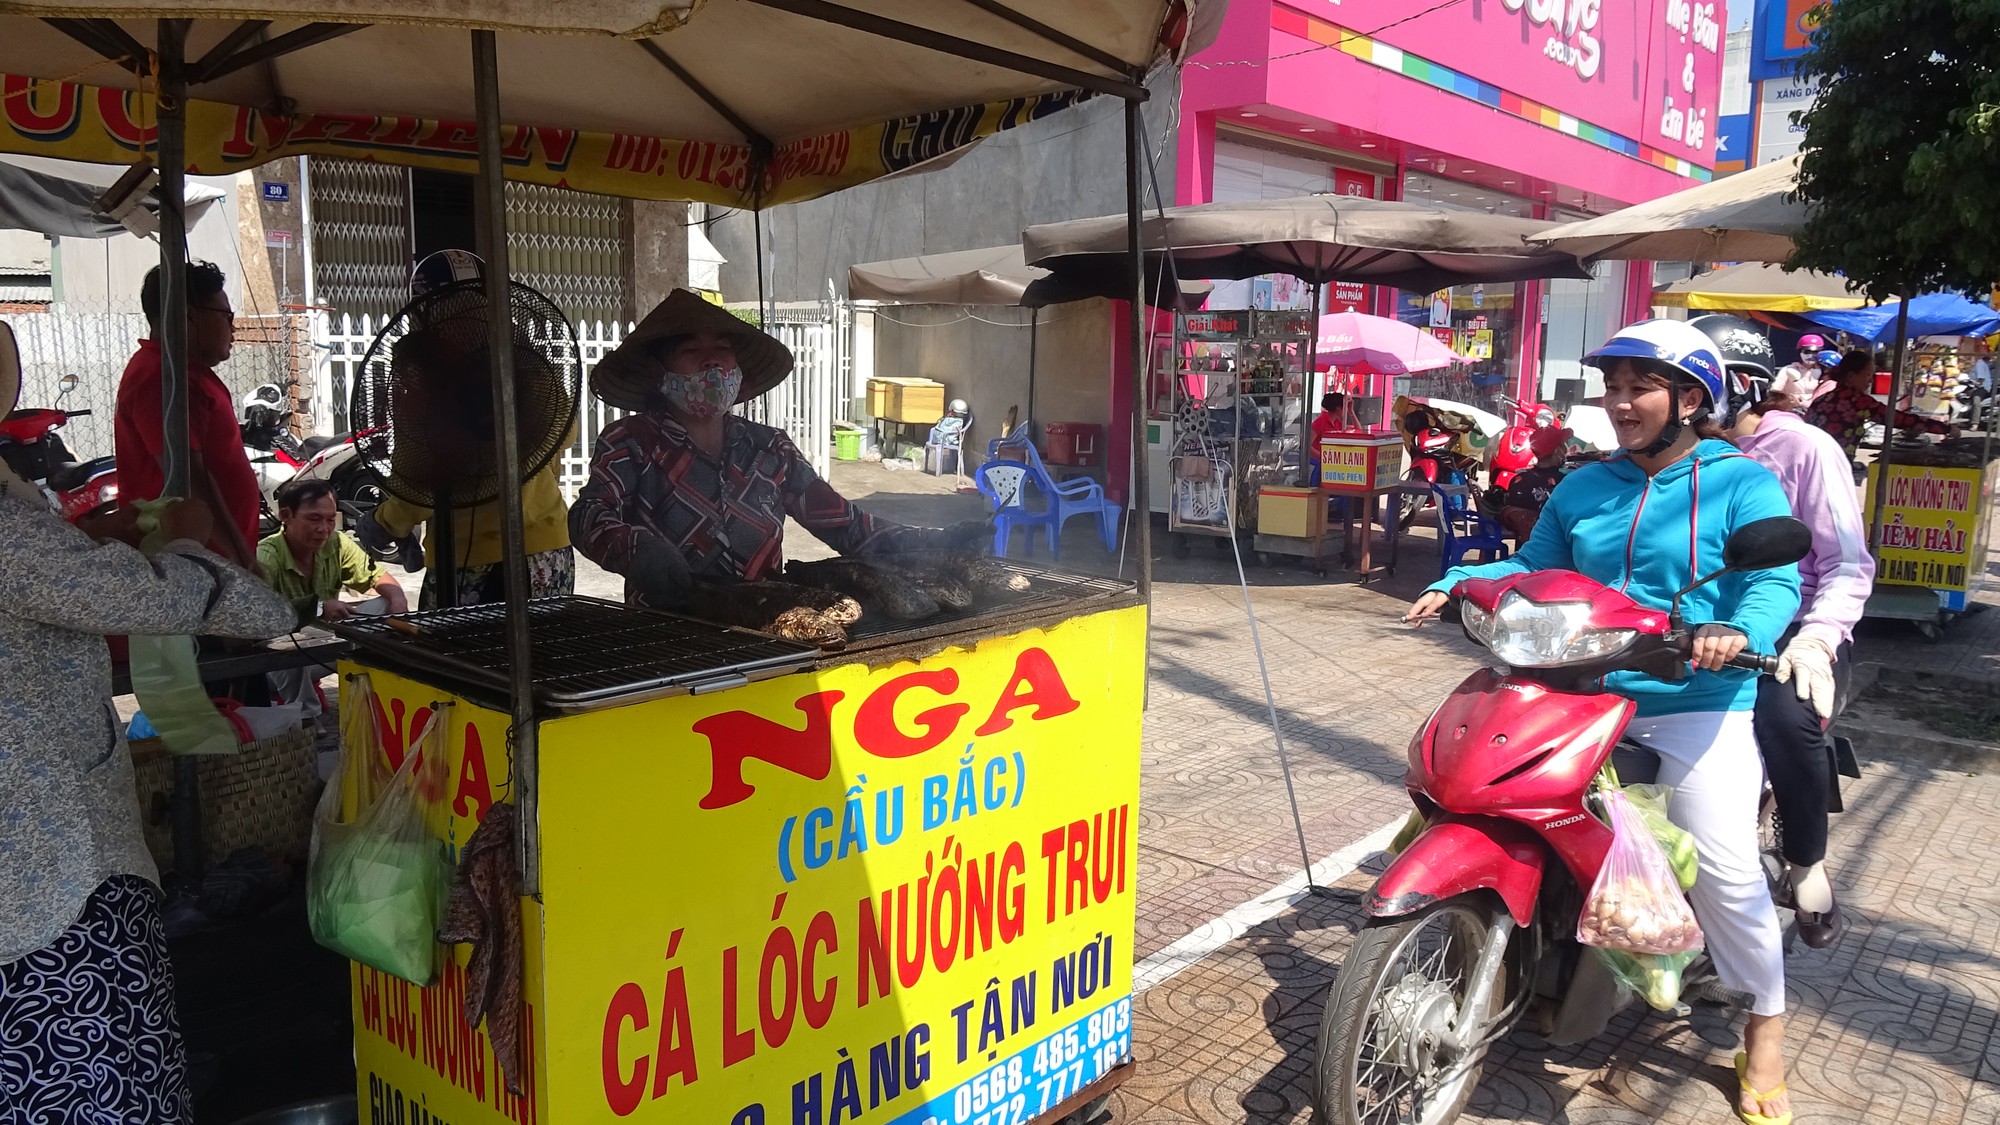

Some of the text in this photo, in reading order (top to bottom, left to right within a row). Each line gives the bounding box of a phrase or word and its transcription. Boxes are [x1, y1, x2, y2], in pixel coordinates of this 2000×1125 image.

[1682, 52, 1695, 93] &
[269, 186, 282, 195] 80
[1947, 480, 1971, 511] TRUI
[1922, 519, 1967, 553] HẢI
[1922, 559, 1945, 587] TẬN
[691, 646, 1081, 810] NGA
[777, 742, 1026, 883] (CẦU BẮC)
[1545, 813, 1587, 830] HONDA
[602, 804, 1129, 1117] CÁ LÓC NƯỚNG TRUI
[950, 977, 1038, 1063] TẬN
[1051, 930, 1114, 1016] NƠI
[954, 1000, 1130, 1123] 0568.485.803
